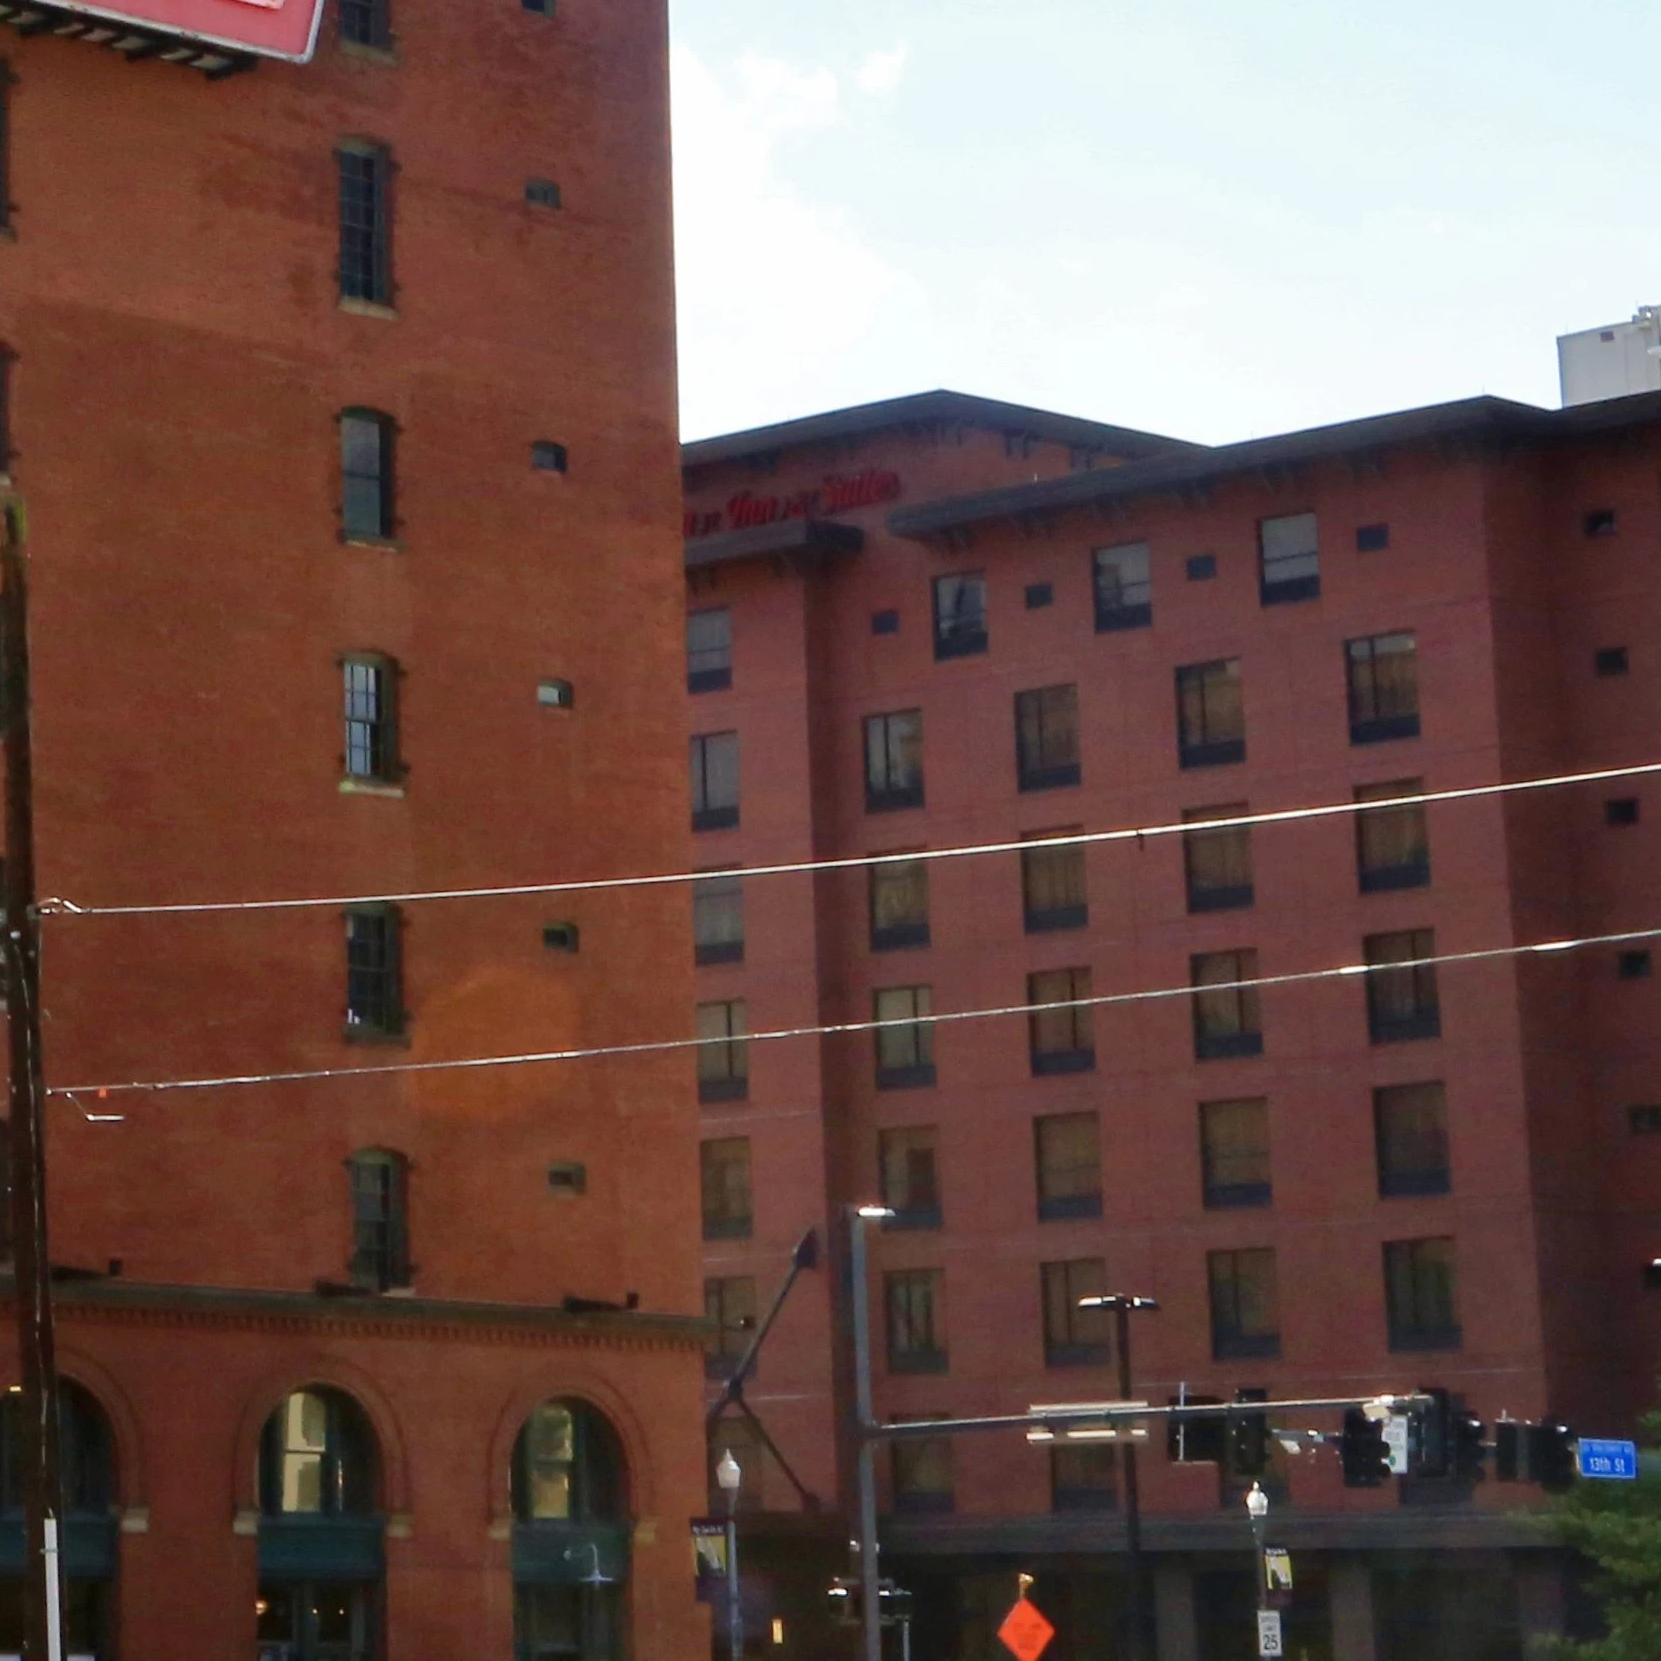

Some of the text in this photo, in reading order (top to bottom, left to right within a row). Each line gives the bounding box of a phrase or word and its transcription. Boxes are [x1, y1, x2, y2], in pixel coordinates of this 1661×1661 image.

[1589, 1456, 1626, 1473] 13th St
[1263, 1634, 1279, 1651] 25
